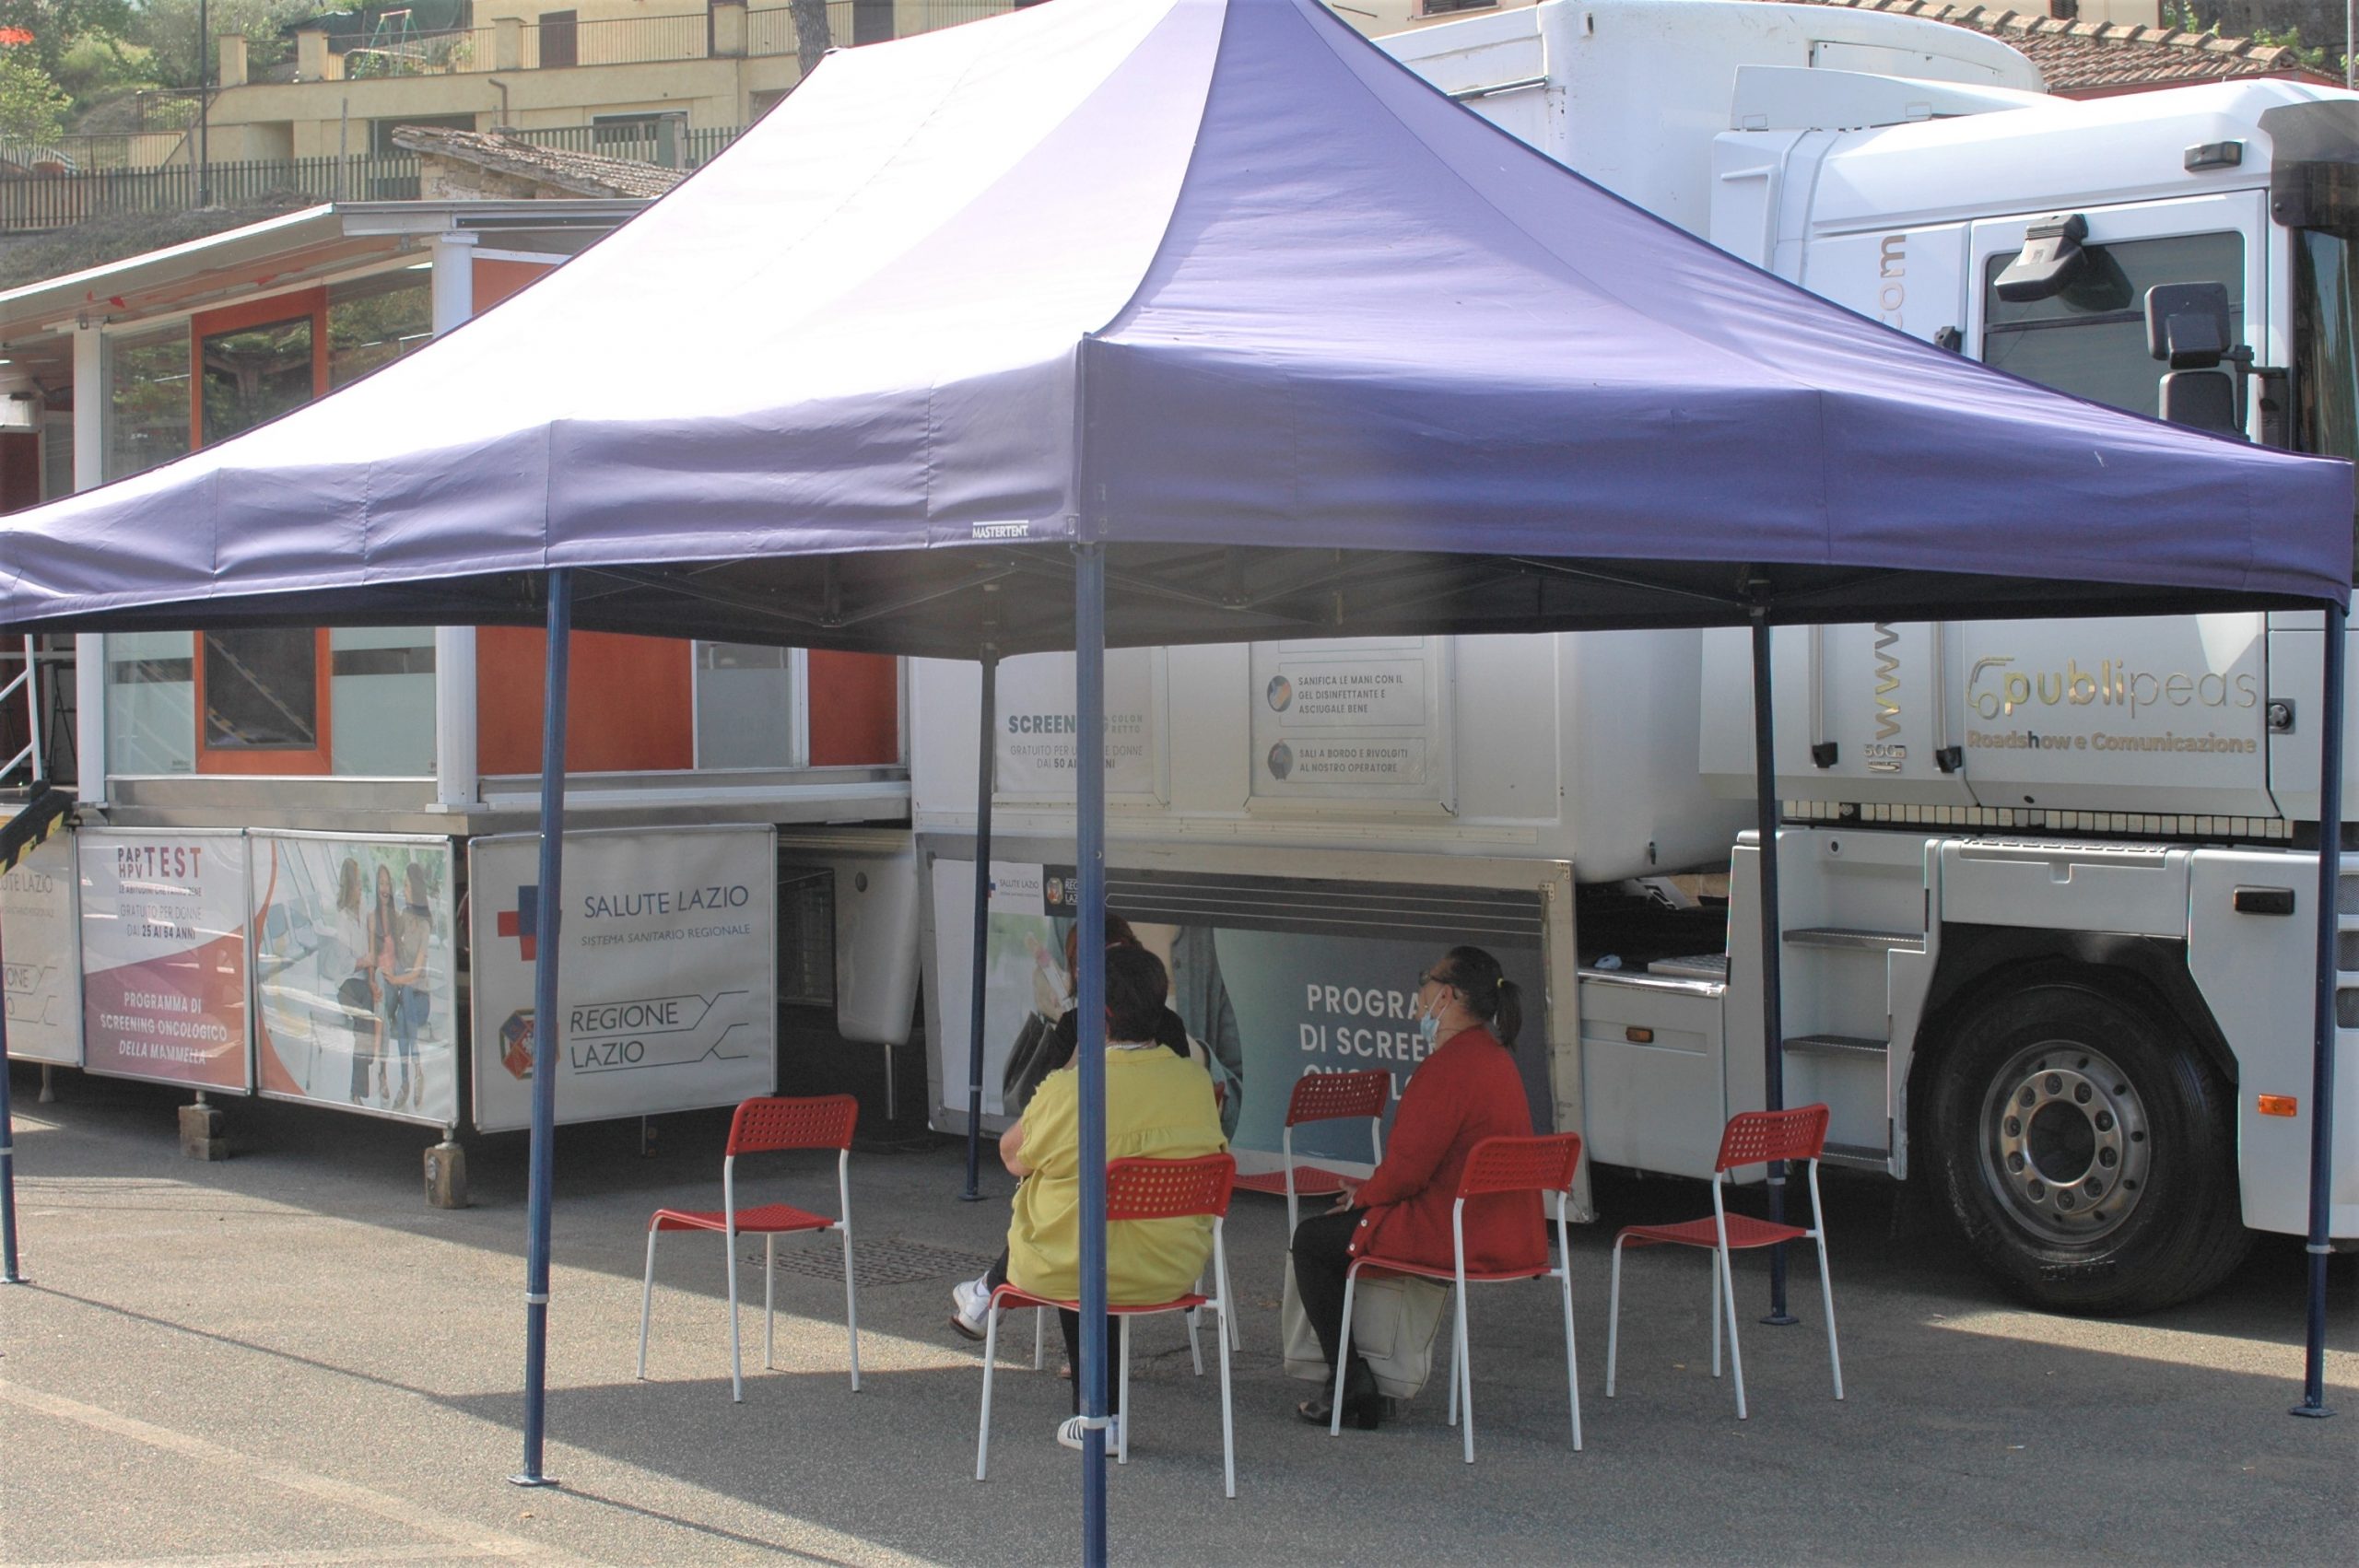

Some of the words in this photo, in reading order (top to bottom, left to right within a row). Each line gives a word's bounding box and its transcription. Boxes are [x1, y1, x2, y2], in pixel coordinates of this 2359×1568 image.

[972, 524, 1028, 539] MASTERTENT
[1297, 675, 1336, 686] SANIFICA
[1339, 675, 1348, 685] LE
[1350, 674, 1373, 685] MANI
[1374, 674, 1394, 685] CON
[1395, 673, 1403, 684] IL
[2003, 657, 2258, 720] publipeas
[1297, 691, 1313, 700] GEL
[1315, 689, 1379, 700] DISINFETTANTE
[1379, 688, 1386, 698] E
[1298, 704, 1345, 714] ASCIUGALE
[1347, 704, 1368, 713] BENE
[1008, 714, 1109, 734] SCREEN
[1111, 714, 1143, 723] COLON
[1111, 725, 1142, 734] RETTO
[1010, 744, 1052, 755] GRATUITO
[1053, 744, 1070, 756] PER
[1111, 744, 1144, 756] DONNE
[1967, 730, 2071, 751] Roadshow
[2073, 735, 2087, 751] e
[2090, 731, 2258, 754] Comunicazione
[1037, 758, 1052, 768] DAI
[1053, 758, 1066, 768] 50
[1299, 748, 1317, 758] SALI
[1319, 748, 1325, 758] A
[1327, 748, 1357, 758] BORDO
[1359, 748, 1365, 758] E
[1366, 748, 1408, 758] RIVOLGITI
[1299, 763, 1309, 773] AL
[1311, 763, 1345, 772] NOSTRO
[1347, 762, 1398, 772] OPERATORE
[117, 847, 141, 863] PAP
[144, 846, 202, 879] TEST
[118, 863, 143, 879] HPV
[22, 874, 53, 894] LAZIO
[1021, 880, 1039, 890] LAZIO
[583, 892, 671, 919] SALUTE
[677, 885, 749, 912] LAZIO
[120, 904, 158, 919] GRATUITO
[159, 905, 173, 919] PER
[175, 907, 202, 921] DONNE
[126, 923, 140, 937] DAI
[142, 924, 152, 937] 25
[153, 925, 162, 938] AI
[175, 926, 196, 940] ANNI
[581, 933, 625, 946] SISTEMA
[628, 929, 686, 944] SANITARIO
[687, 923, 751, 939] REGIONALE
[123, 991, 188, 1012] PROGRAMMA
[191, 998, 202, 1014] DI
[1307, 984, 1419, 1021] PROGRA
[569, 1001, 679, 1033] REGIONE
[100, 1013, 156, 1034] SCREENING
[158, 1019, 228, 1042] ONCOLOGICO
[119, 1039, 147, 1059] DELLA
[149, 1042, 206, 1066] MAMMELLA
[1299, 1024, 1327, 1052] DI
[1336, 1026, 1435, 1062] SCREE
[570, 1040, 645, 1069] LAZIO
